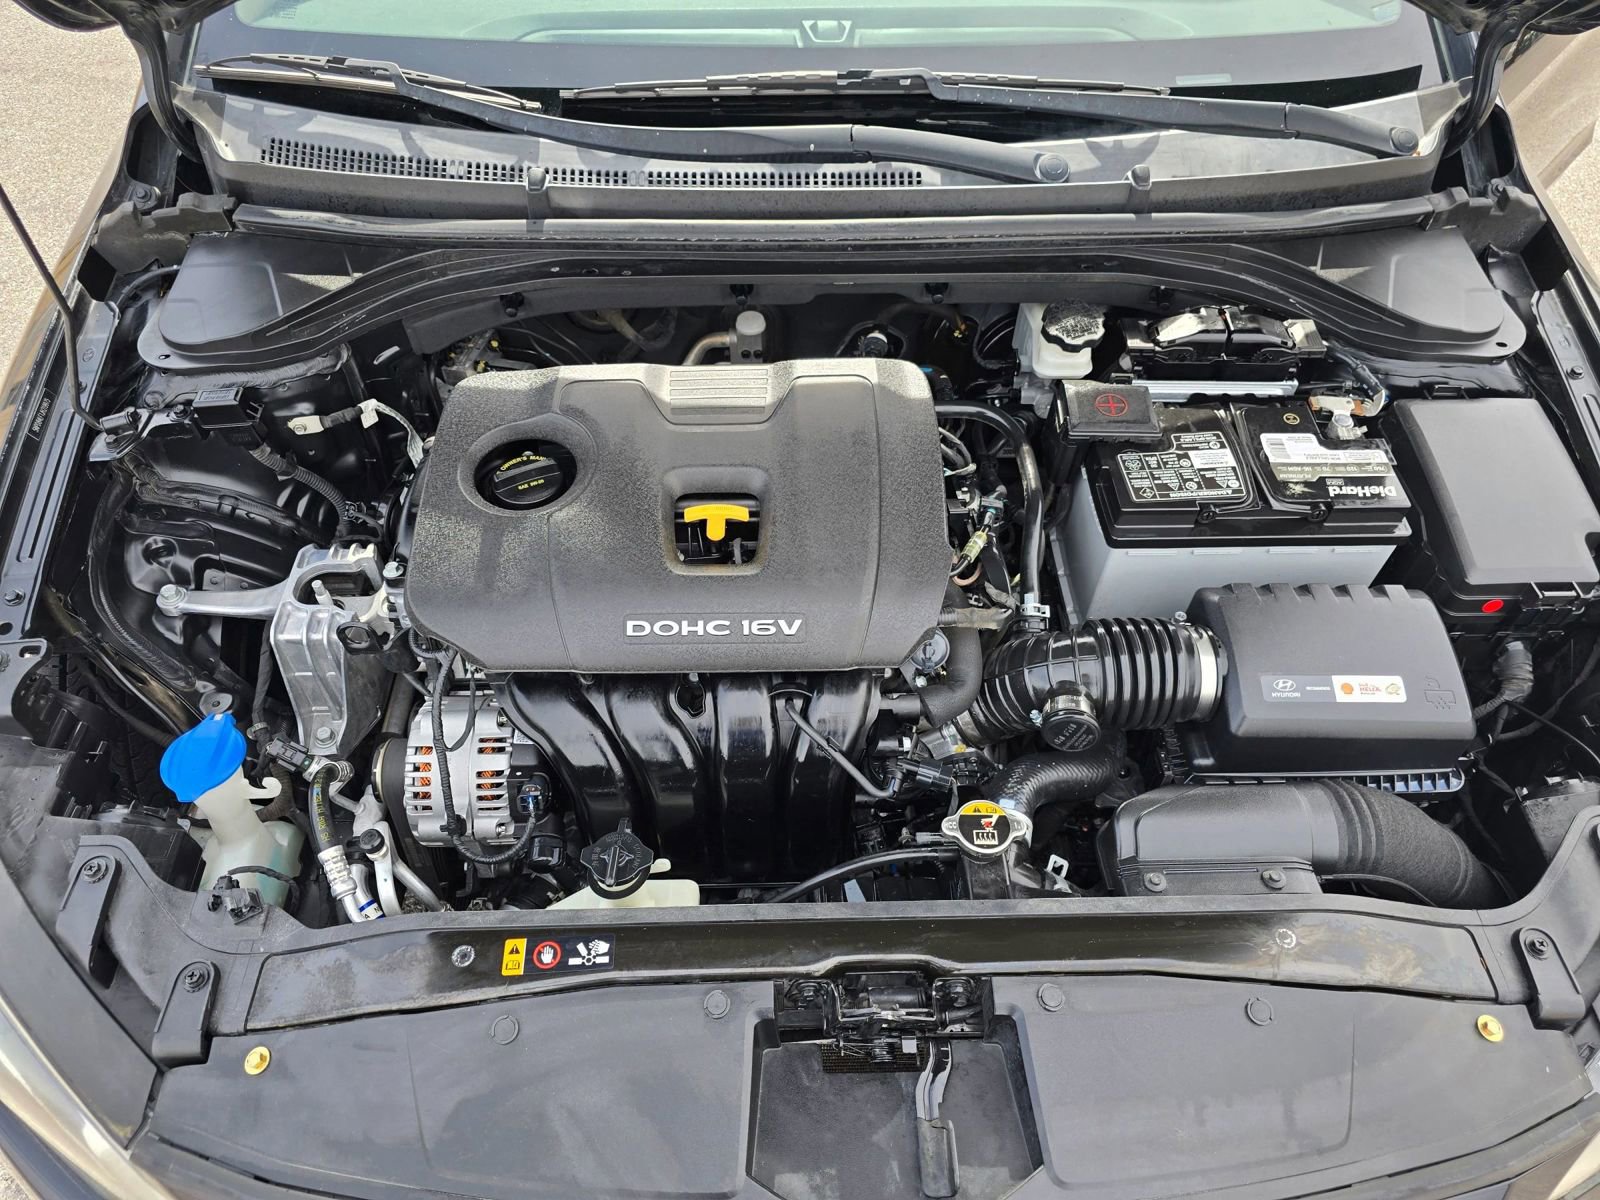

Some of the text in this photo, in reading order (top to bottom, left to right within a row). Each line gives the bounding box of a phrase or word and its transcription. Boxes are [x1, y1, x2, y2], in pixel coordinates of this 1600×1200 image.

[1327, 486, 1397, 497] DieHard
[626, 619, 802, 636] DOHC 16V
